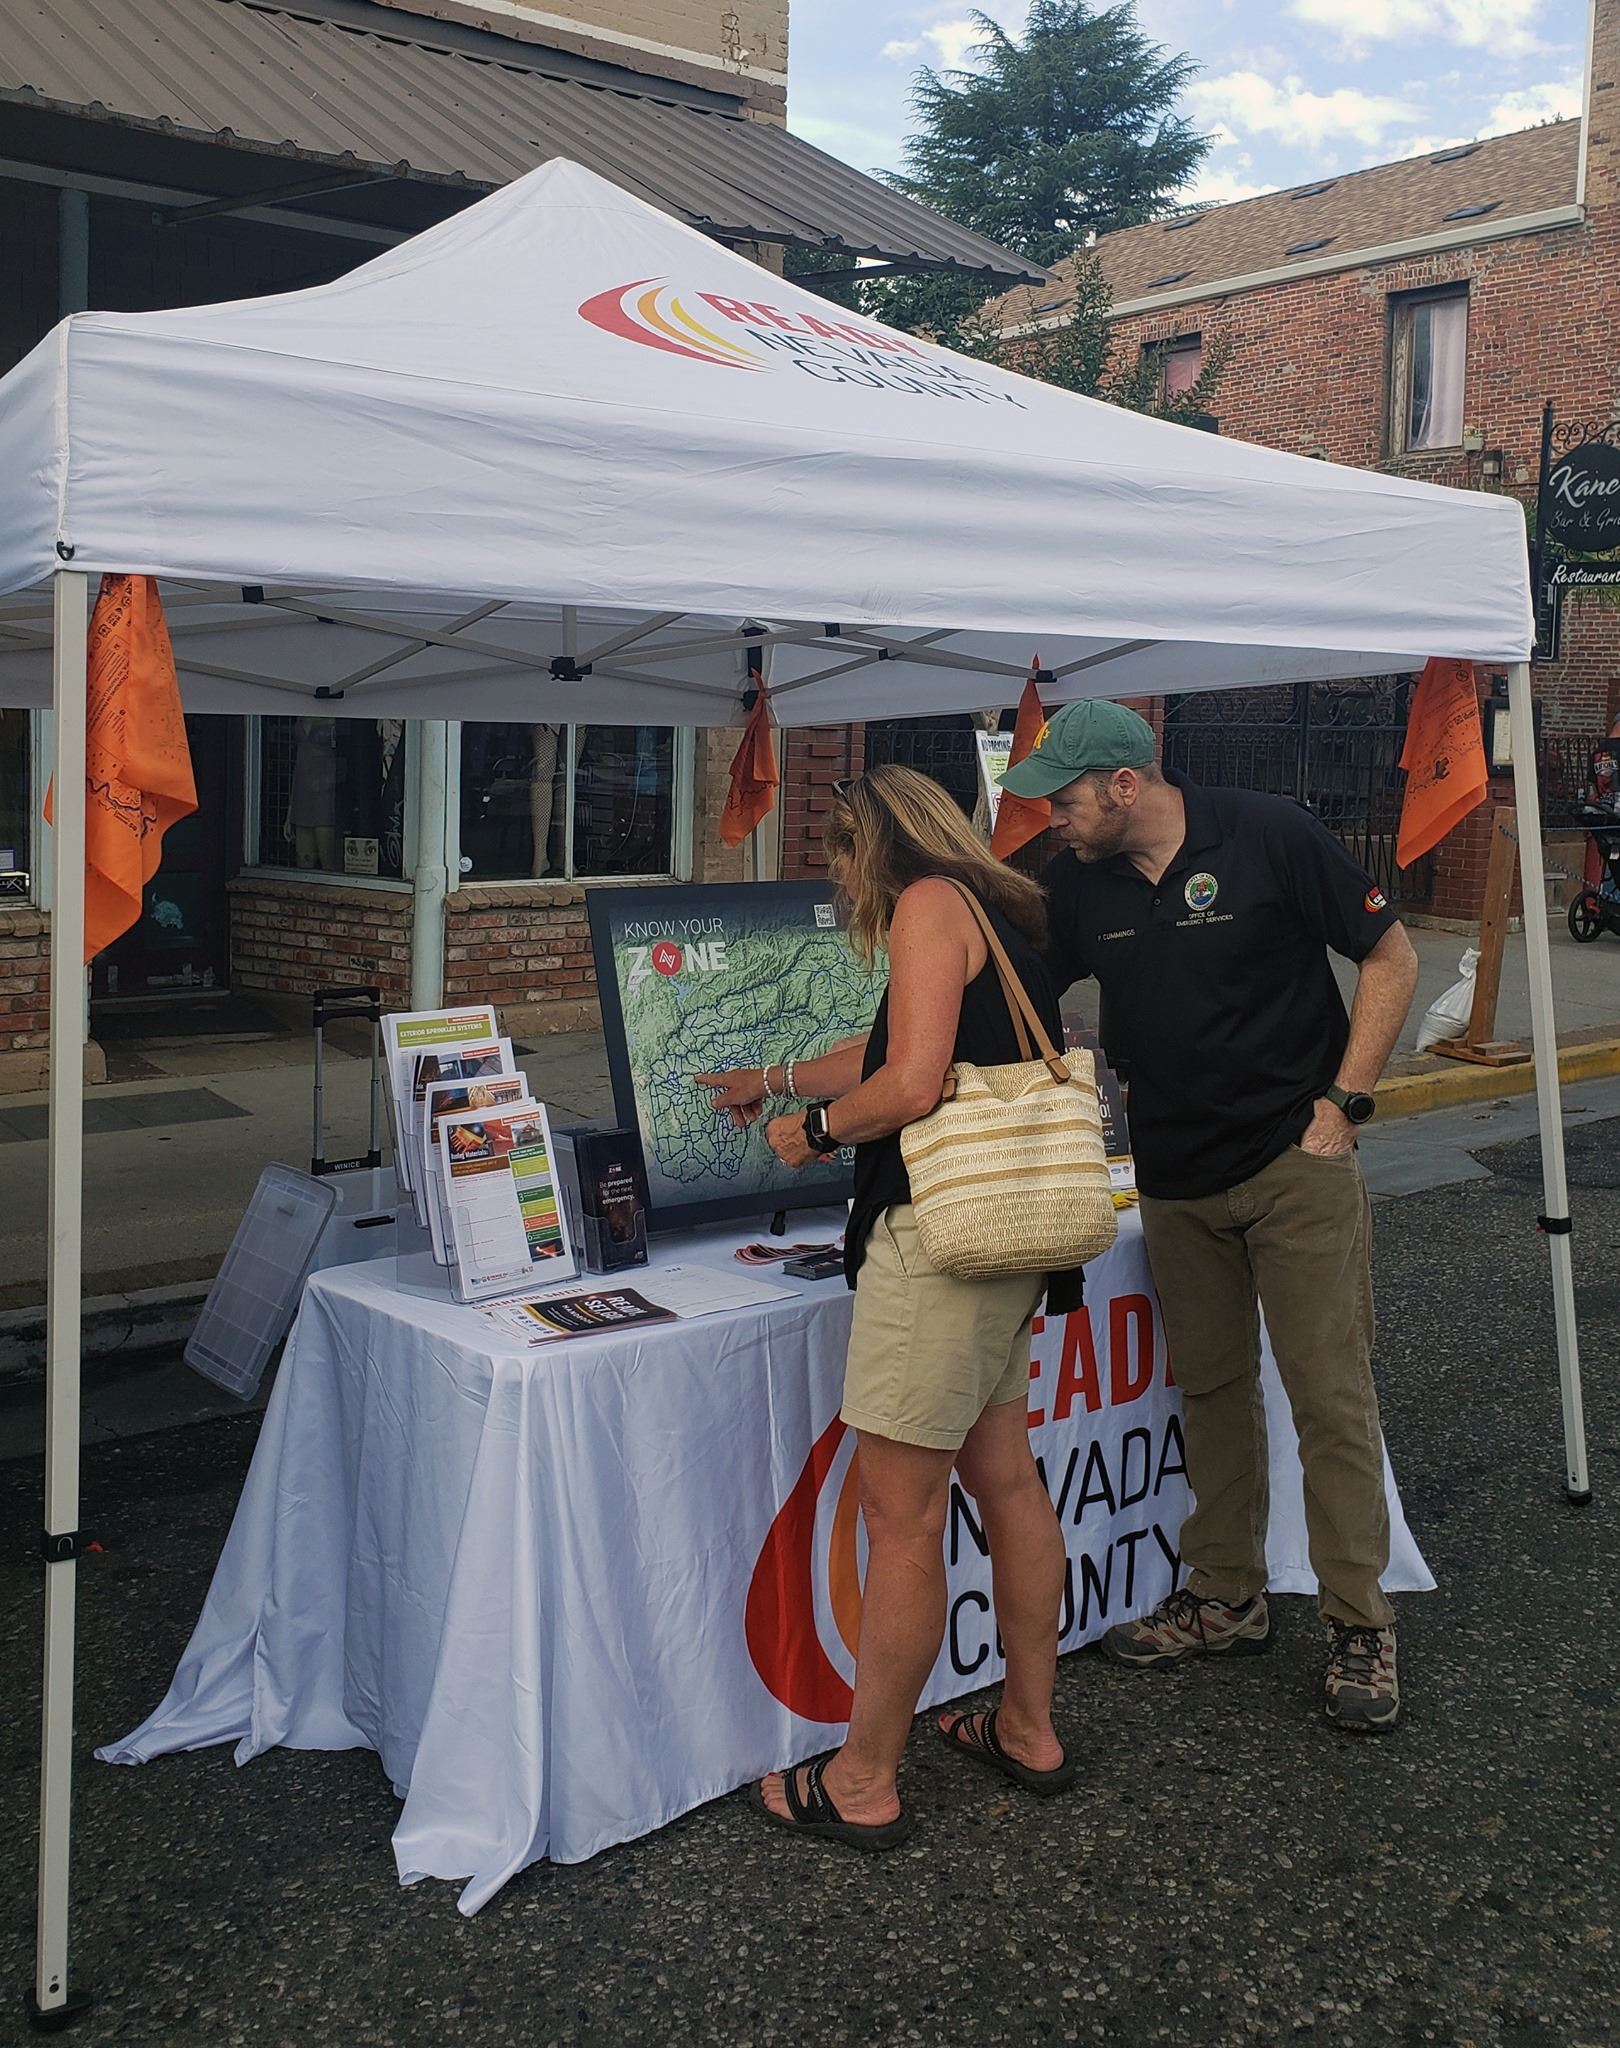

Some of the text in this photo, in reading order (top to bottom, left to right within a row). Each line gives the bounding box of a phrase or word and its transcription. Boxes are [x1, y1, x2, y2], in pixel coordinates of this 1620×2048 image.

[694, 291, 933, 361] READY
[744, 328, 991, 387] NEVADA
[792, 358, 1029, 410] COUNTY
[1551, 510, 1574, 528] Bar
[1578, 511, 1592, 528] &
[1176, 913, 1234, 927] EMERGENCY SERVICES
[1188, 911, 1205, 919] OFFICE
[623, 917, 725, 938] KNOW YOUR
[1103, 928, 1136, 940] CUMMINGS
[334, 1160, 361, 1171] WINICE
[608, 1176, 633, 1188] prepared
[472, 1288, 585, 1310] GENERATOR SAFETY
[950, 1414, 1193, 1566] NVADA
[949, 1522, 1182, 1676] CUNTY
